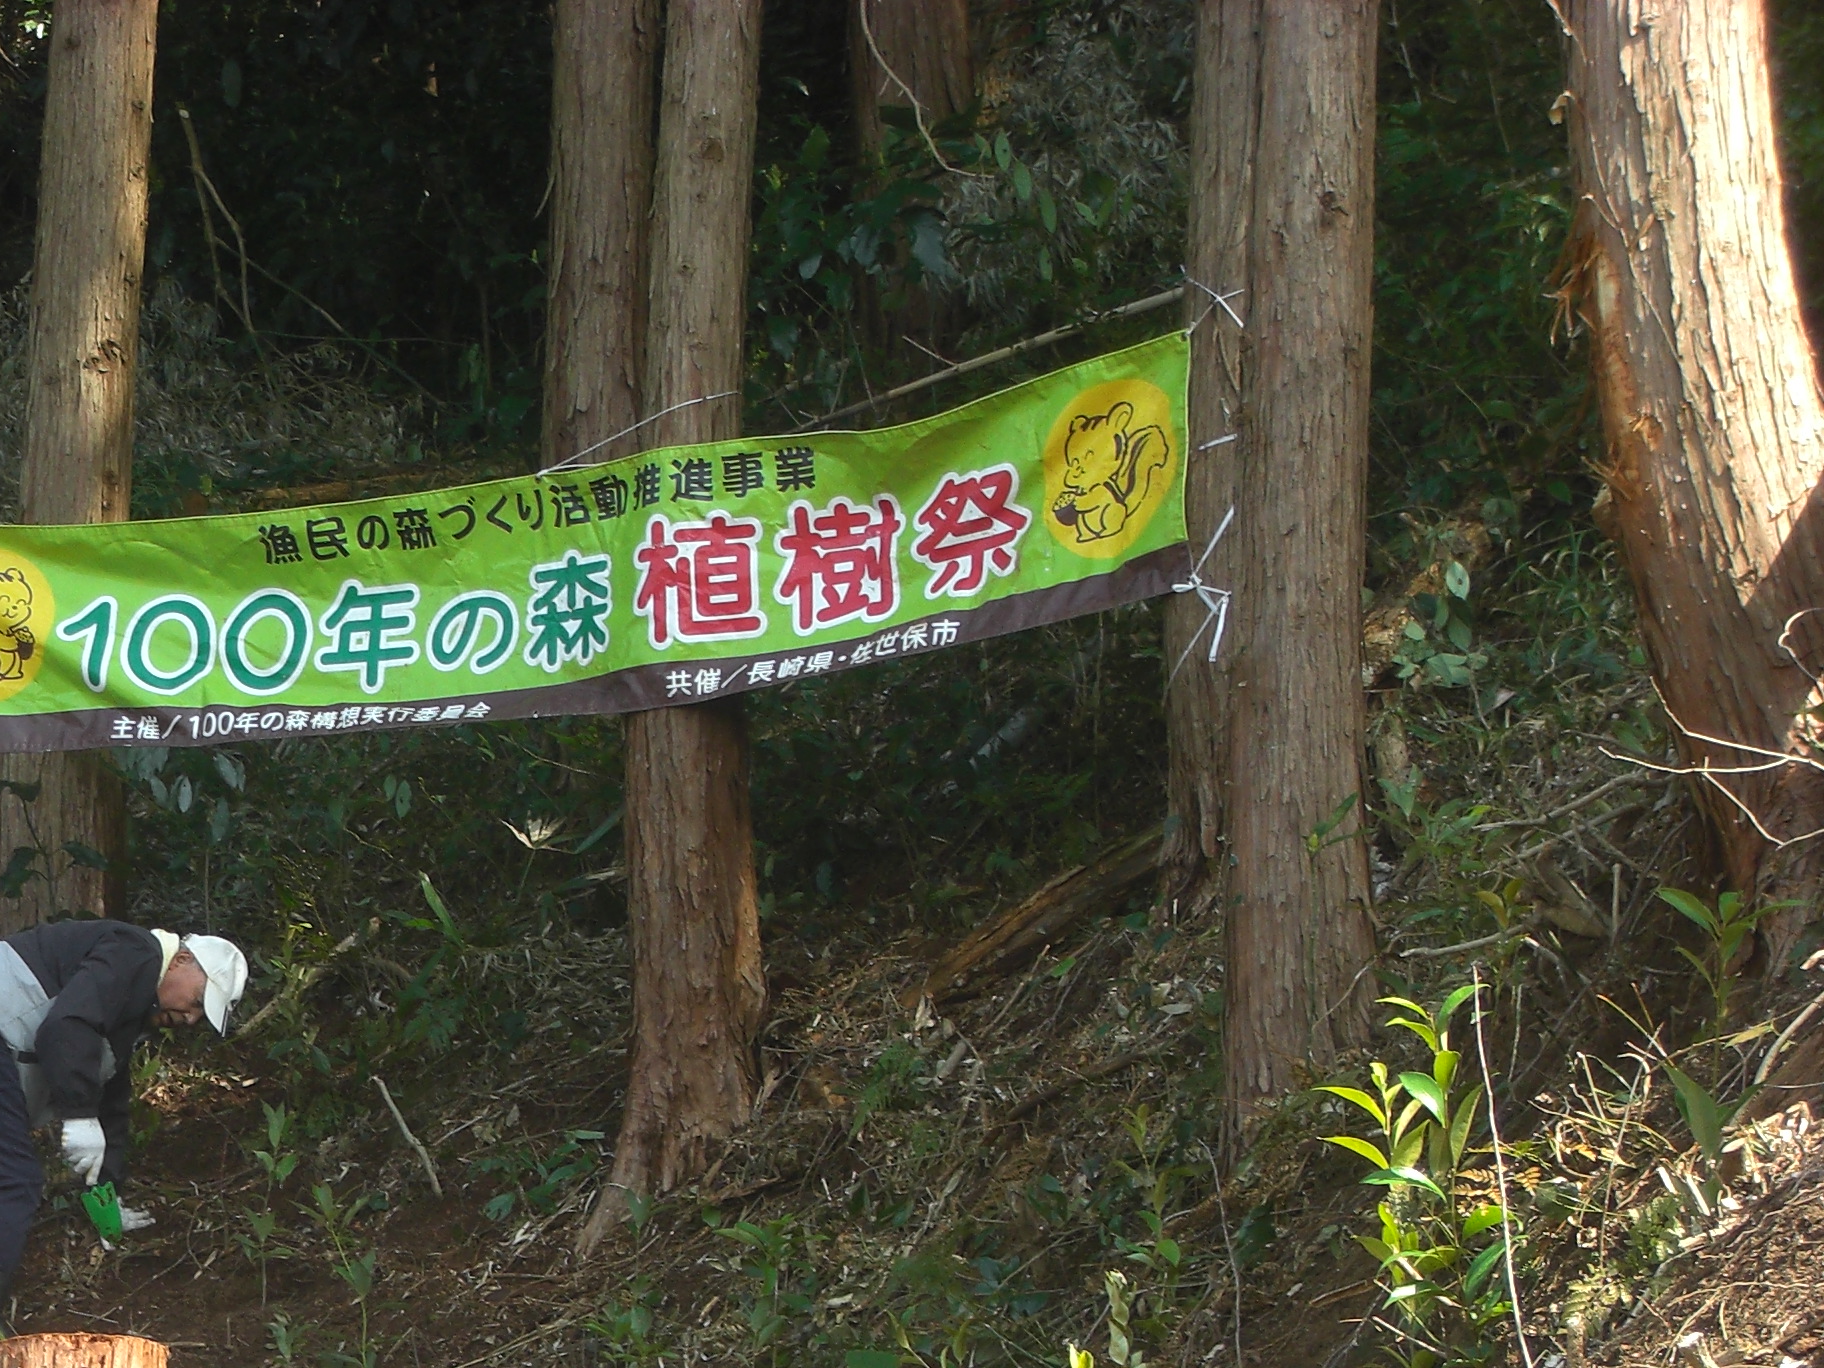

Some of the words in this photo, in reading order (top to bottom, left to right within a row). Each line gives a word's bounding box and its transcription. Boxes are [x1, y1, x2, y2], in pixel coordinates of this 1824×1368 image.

[258, 446, 816, 565] 漁民の森づくり活動推進事業
